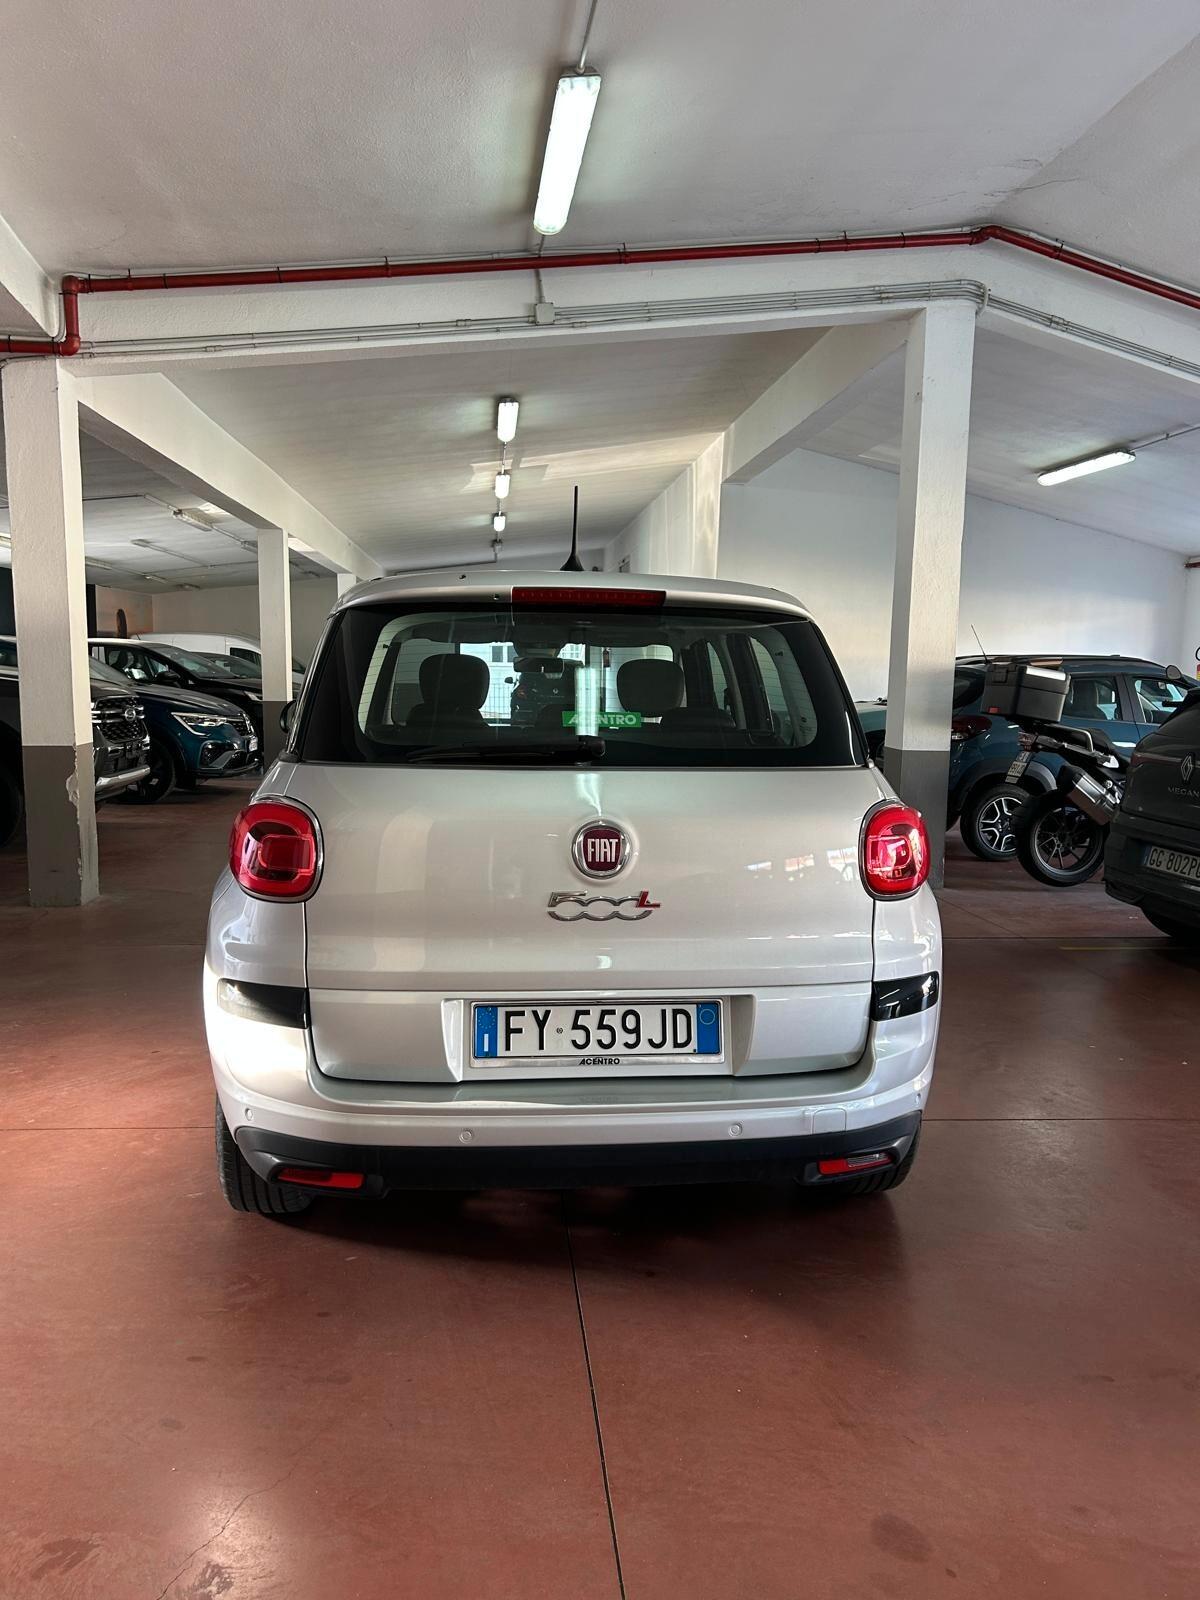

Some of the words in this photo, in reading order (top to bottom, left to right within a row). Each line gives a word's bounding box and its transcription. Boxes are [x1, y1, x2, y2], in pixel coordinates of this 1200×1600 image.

[587, 838, 618, 862] FIAT
[547, 890, 660, 921] 500L
[504, 1009, 551, 1052] FY
[571, 1008, 692, 1050] 559JD
[579, 1057, 620, 1065] ACENTRO
